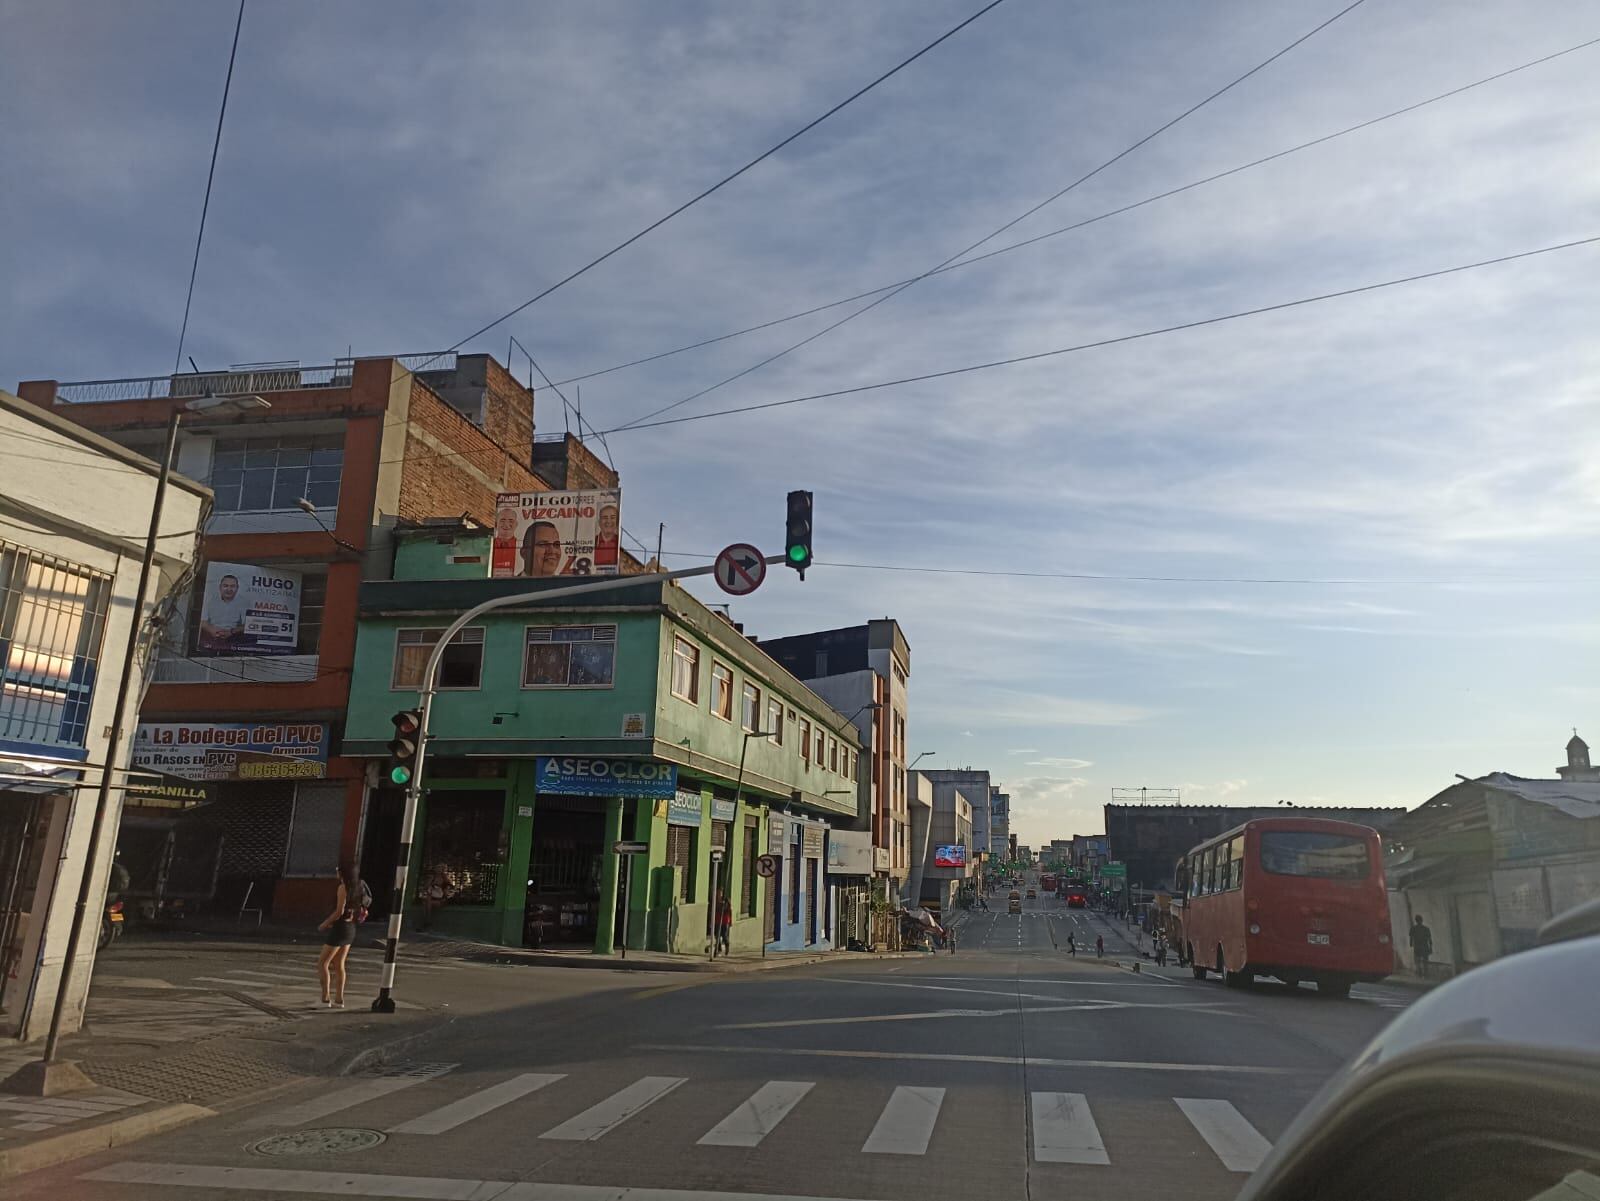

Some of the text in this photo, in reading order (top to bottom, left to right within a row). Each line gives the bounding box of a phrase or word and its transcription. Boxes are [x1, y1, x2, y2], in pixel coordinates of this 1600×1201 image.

[522, 496, 571, 506] DIEGO
[522, 507, 595, 520] VIZCAINO
[252, 575, 294, 590] HUGO
[255, 602, 289, 612] MARCA
[281, 622, 293, 633] 51
[153, 724, 323, 747] La Bodega del PVC
[272, 746, 319, 755] Armenia
[153, 754, 191, 765] RASOS
[193, 756, 206, 765] EN
[207, 753, 237, 766] PVC
[544, 757, 673, 781] ASEOCLOR
